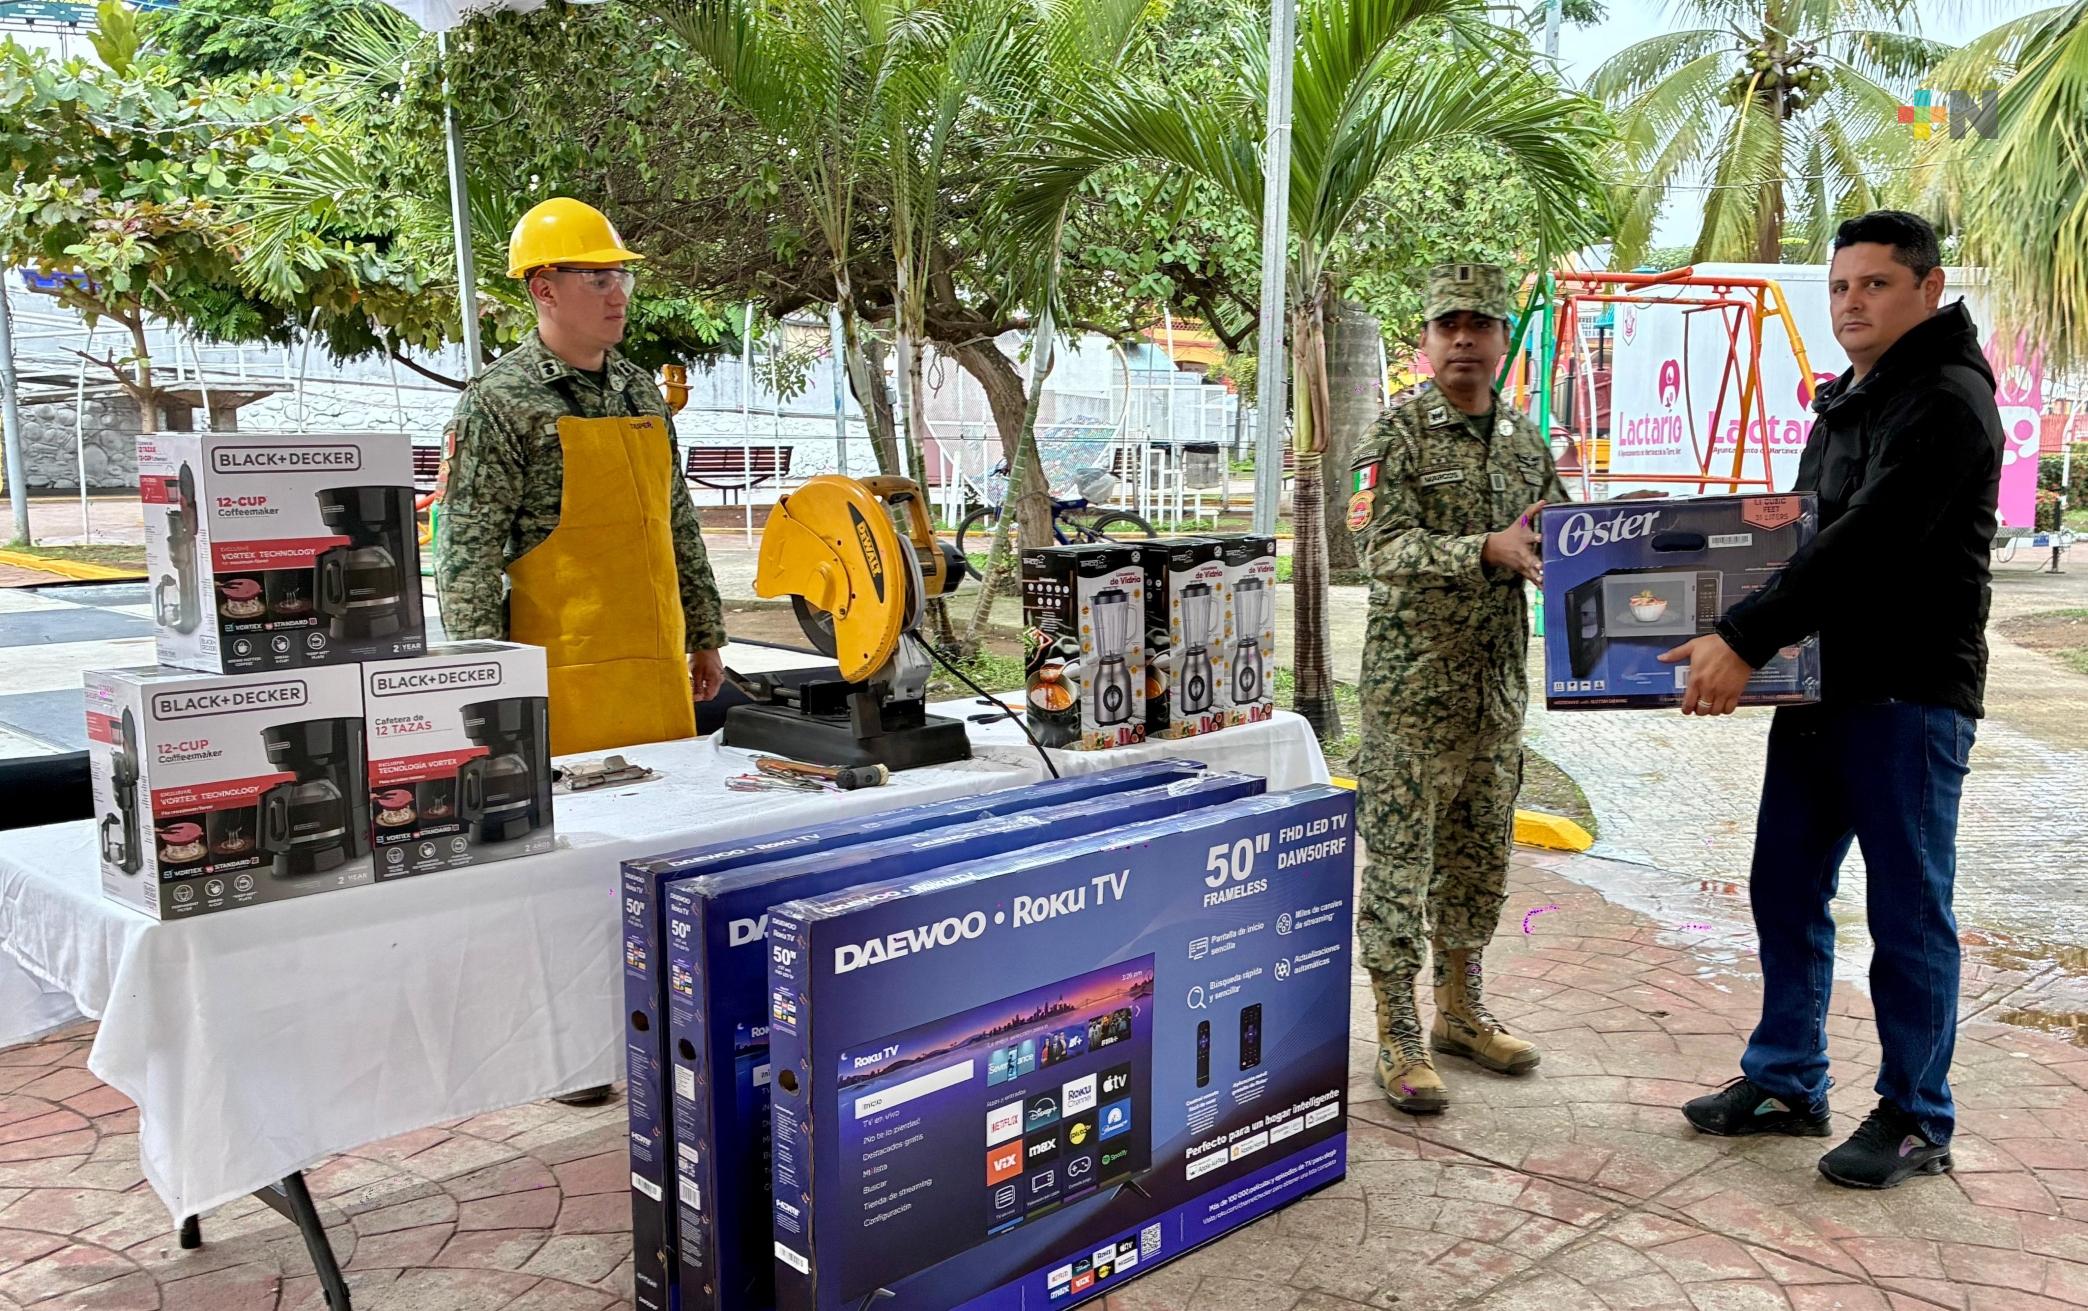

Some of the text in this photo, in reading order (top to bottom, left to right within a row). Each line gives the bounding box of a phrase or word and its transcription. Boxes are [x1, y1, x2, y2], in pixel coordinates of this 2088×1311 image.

[1708, 411, 1814, 445] Lactar
[220, 452, 354, 467] BLACK+DECKER
[216, 496, 267, 507] 12-CUP
[218, 507, 279, 517] Coffeemaker
[1557, 510, 1661, 557] Oster
[221, 548, 316, 560] VORTEX TECHNOLOGY
[1121, 576, 1141, 584] Vidrio
[1204, 570, 1222, 578] Vidrio
[273, 619, 308, 627] STANDARD
[377, 668, 496, 690] BLACK+DECKER
[161, 688, 300, 713] BLACK+DECKER
[375, 716, 411, 725] Cafetera
[376, 721, 432, 736] 12 TAZAS
[158, 739, 209, 754] 12-CUP
[158, 749, 223, 764] Coffeemaker
[378, 758, 457, 774] TECNOLOGÍA VORTEX
[160, 786, 260, 805] VORTEX TECHNOLOGY
[1279, 814, 1347, 843] FHD LED TV
[1204, 832, 1271, 888] 50"
[1278, 837, 1346, 869] DAW50FRF
[215, 859, 251, 871] STANDARD
[337, 876, 344, 884] 2
[1204, 878, 1268, 907] FRAMELESS
[626, 898, 645, 915] 50"
[1312, 907, 1319, 915] de
[672, 920, 691, 938] 50"
[834, 869, 1129, 974] DAEWOO Roku TV
[1211, 922, 1264, 944] Pantalla de inicio
[773, 945, 796, 965] 50"
[1211, 942, 1236, 955] sencilla
[1294, 943, 1340, 963] Actualizaciones
[854, 1044, 899, 1068] Roku TV
[1186, 1136, 1227, 1158] Perfecto
[1229, 1126, 1250, 1142] para
[1252, 1120, 1263, 1131] un
[1265, 1108, 1291, 1125] hogar
[1292, 1089, 1339, 1113] inteligente
[863, 1133, 924, 1161] Destacados gratis
[1028, 1138, 1056, 1157] max
[863, 1180, 888, 1194] Buscar
[864, 1178, 932, 1211] Tienda de streaming
[864, 1202, 912, 1227] Configuración
